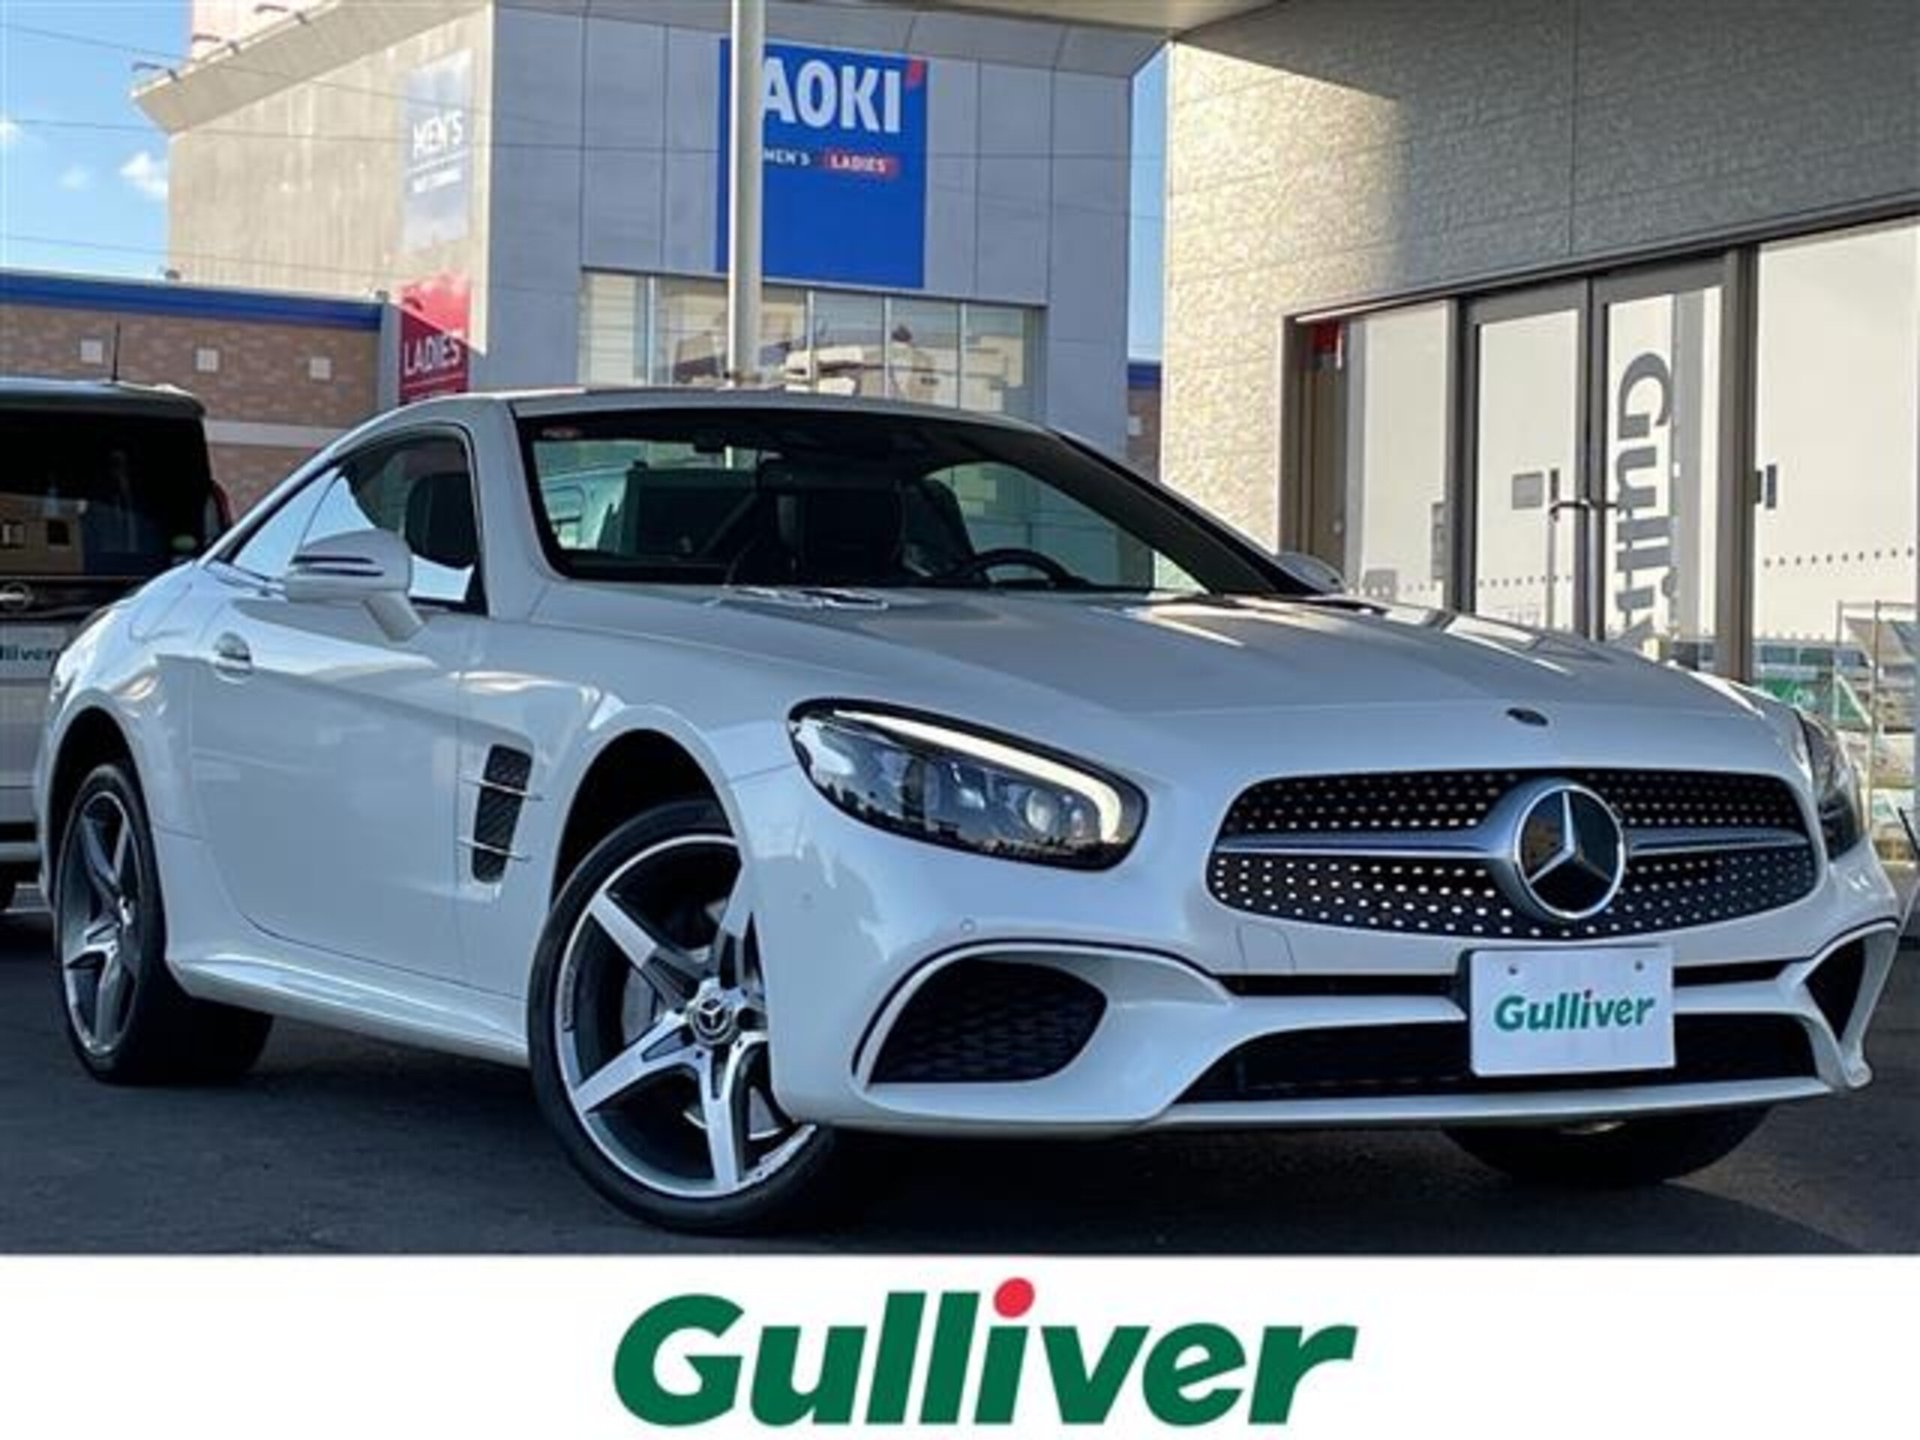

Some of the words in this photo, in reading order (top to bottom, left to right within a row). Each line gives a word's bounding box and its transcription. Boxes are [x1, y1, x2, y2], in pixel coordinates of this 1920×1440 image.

[763, 57, 900, 132] AOKI
[830, 153, 887, 173] LADIES
[405, 333, 461, 376] LADIES
[1494, 989, 1655, 1032] Gulliver
